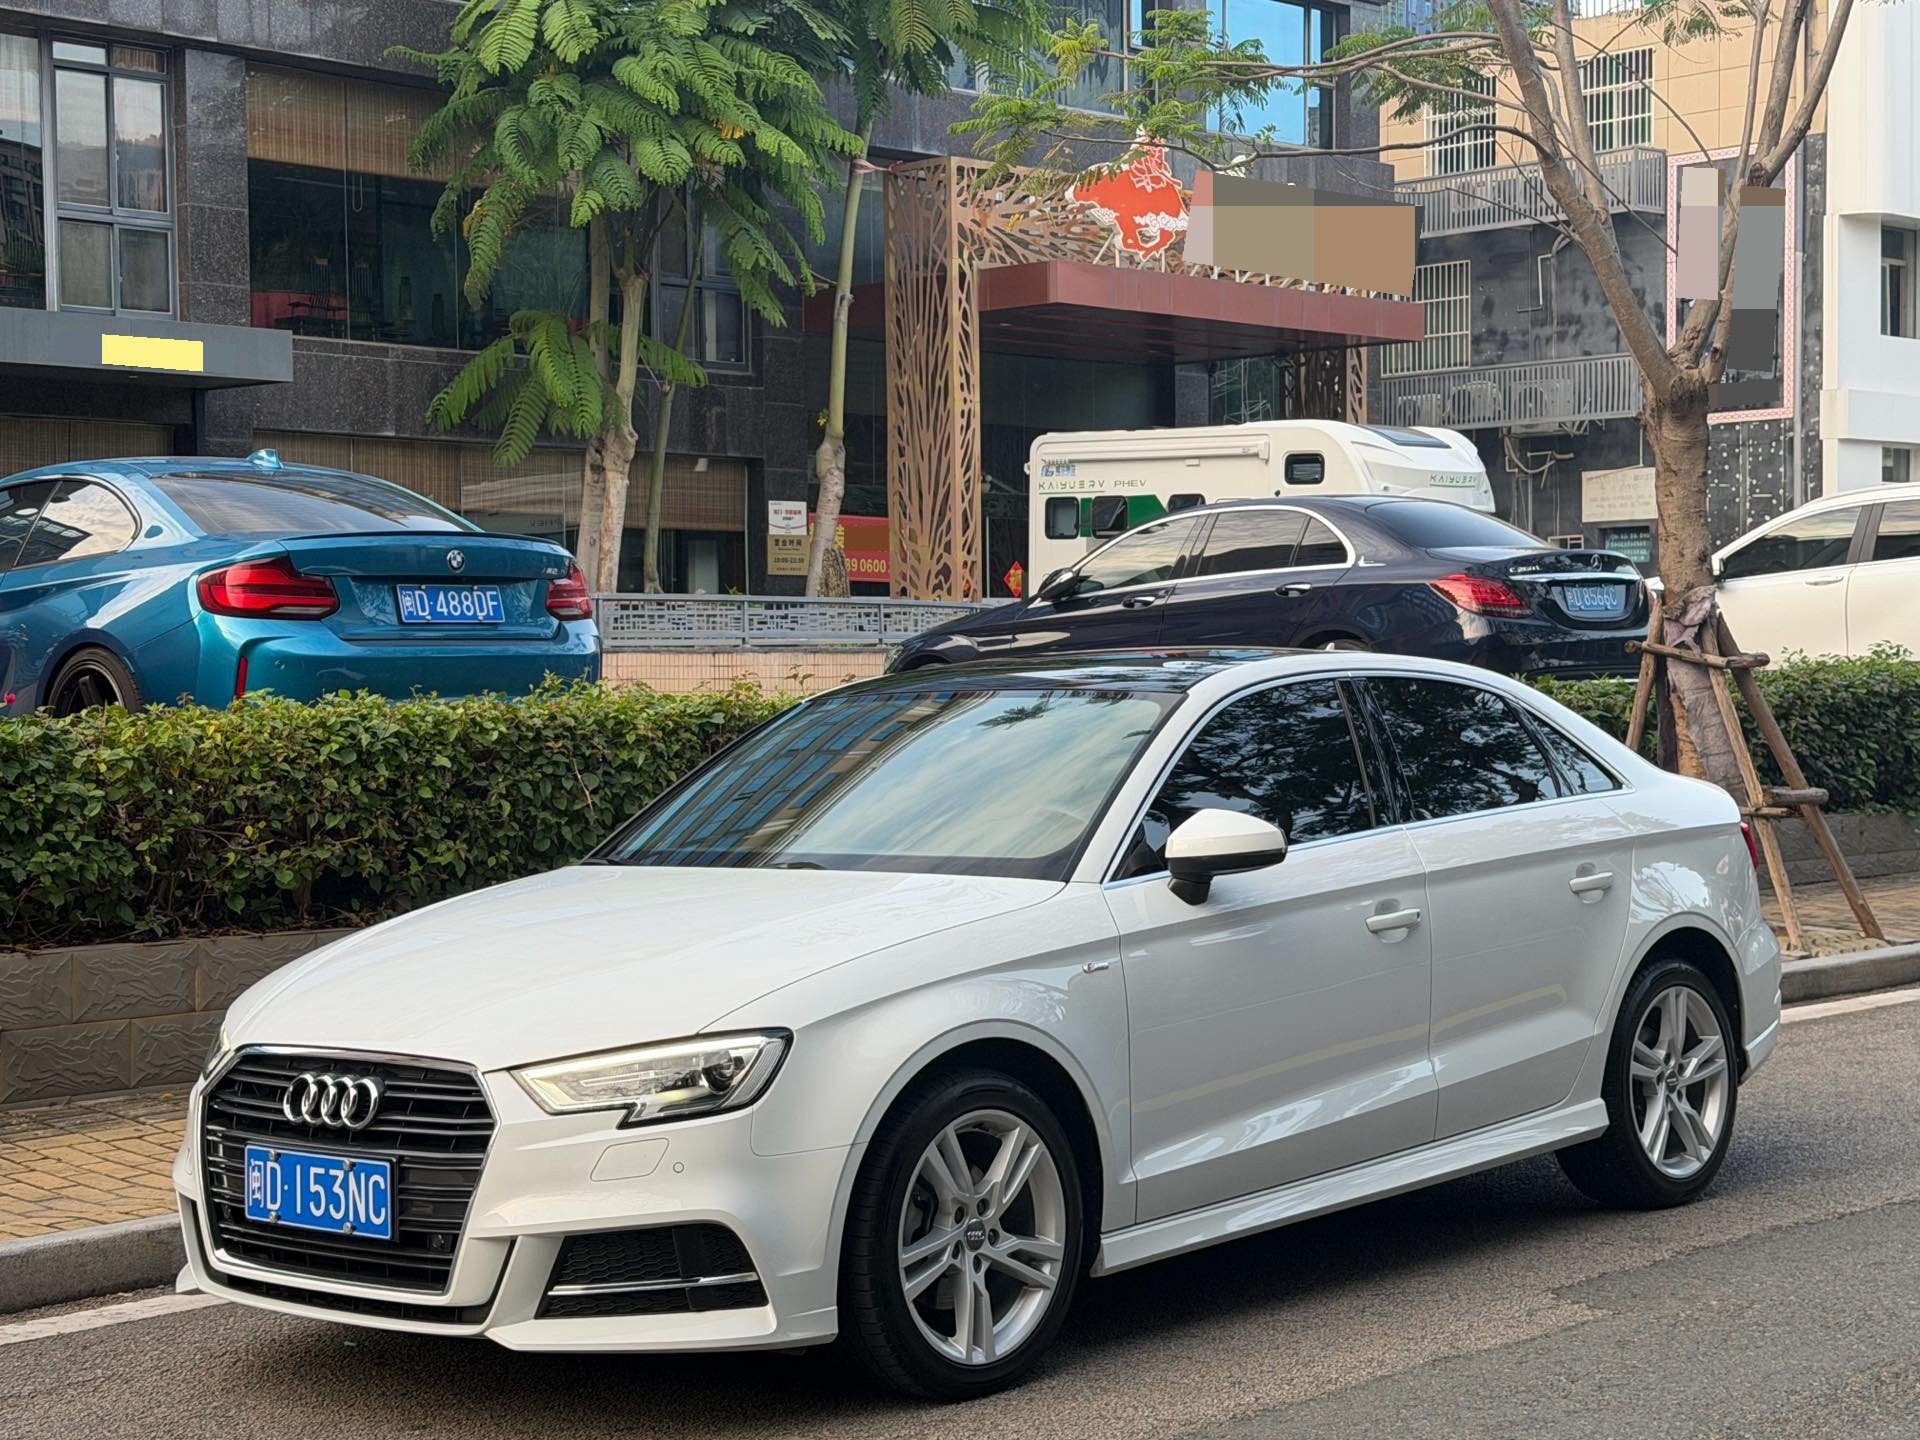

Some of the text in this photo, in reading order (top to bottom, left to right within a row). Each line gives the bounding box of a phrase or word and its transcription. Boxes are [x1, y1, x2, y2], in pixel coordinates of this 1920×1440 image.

[1038, 480, 1148, 490] KAIYUERV PHEV
[860, 559, 887, 573] 0600
[249, 1158, 387, 1226] 闽D·153NC
